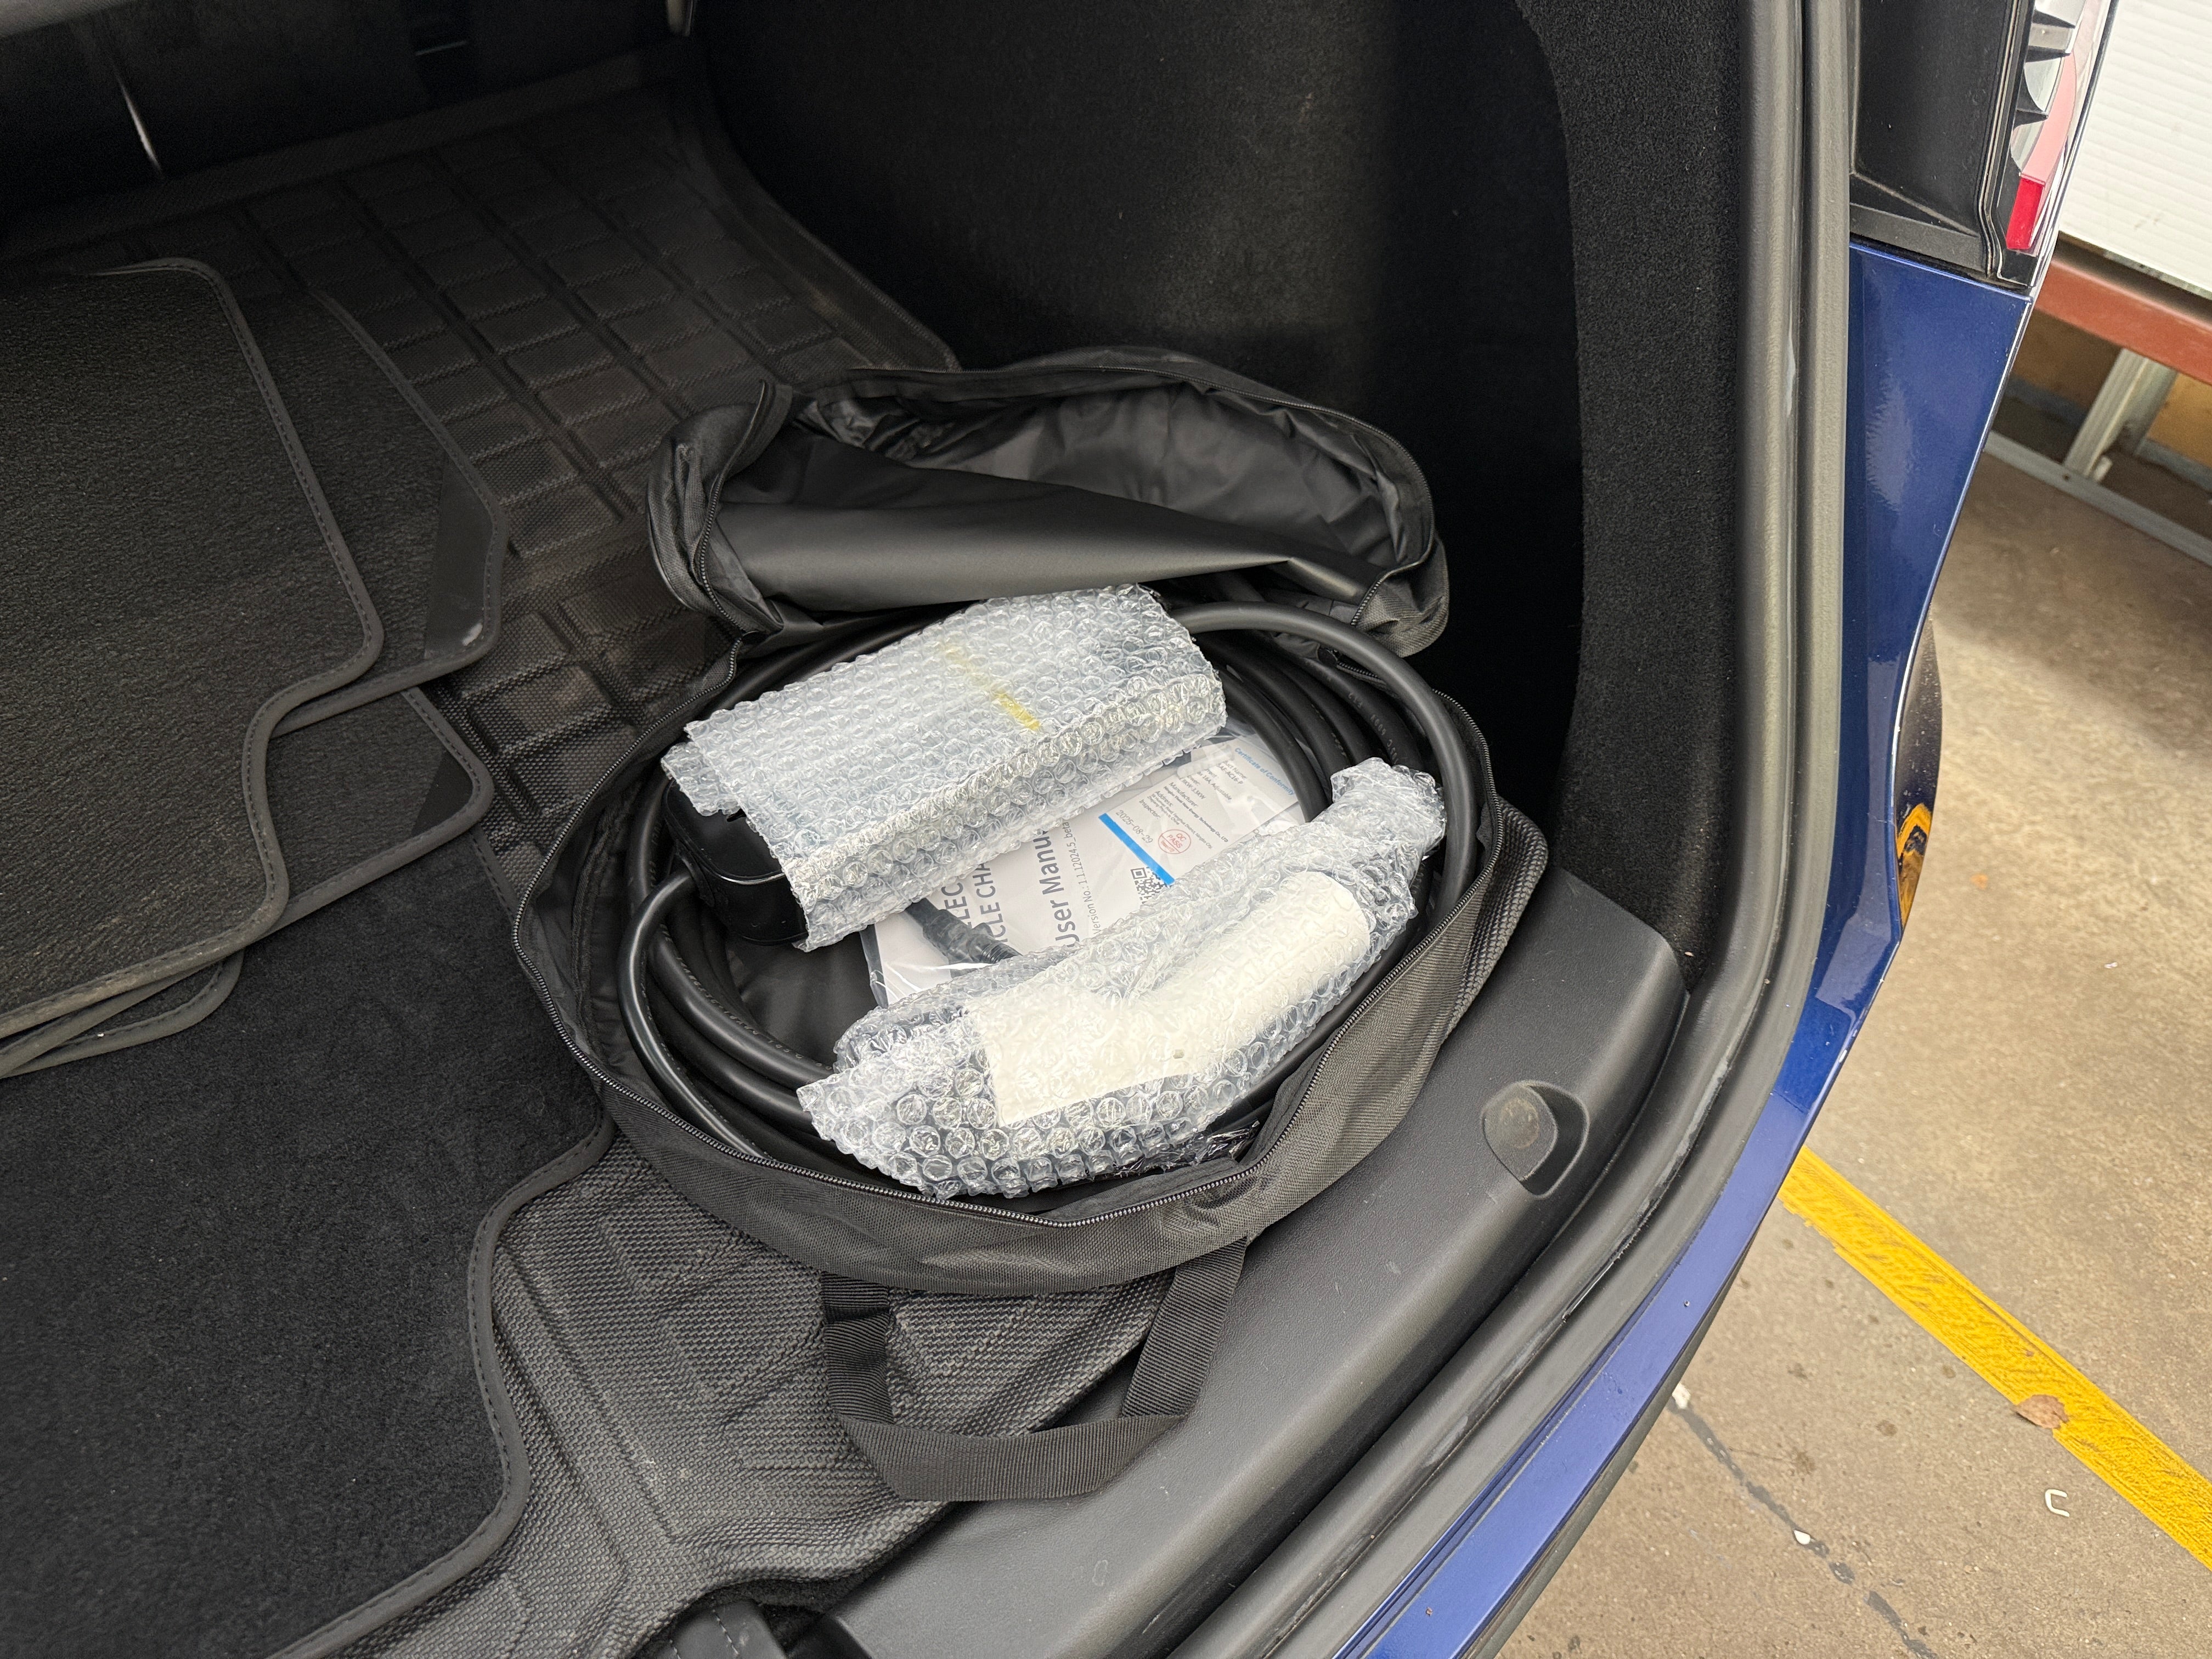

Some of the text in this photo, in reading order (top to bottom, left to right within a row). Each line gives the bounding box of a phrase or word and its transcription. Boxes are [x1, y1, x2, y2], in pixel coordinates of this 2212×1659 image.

[1235, 748, 1261, 769] Certificate
[1266, 772, 1295, 795] Conformity
[1155, 791, 1173, 807] Address:
[1169, 782, 1198, 807] Manufacturer:
[1139, 799, 1161, 820] Inspector:
[1189, 808, 1199, 819] Energy
[1199, 817, 1216, 832] Technology
[1115, 810, 1153, 843] 2025-08-29
[1176, 833, 1187, 842] QC
[1167, 834, 1183, 849] PASS
[1033, 830, 1080, 947] User Manu
[1082, 885, 1092, 903] No.:
[1087, 902, 1101, 935] Version
